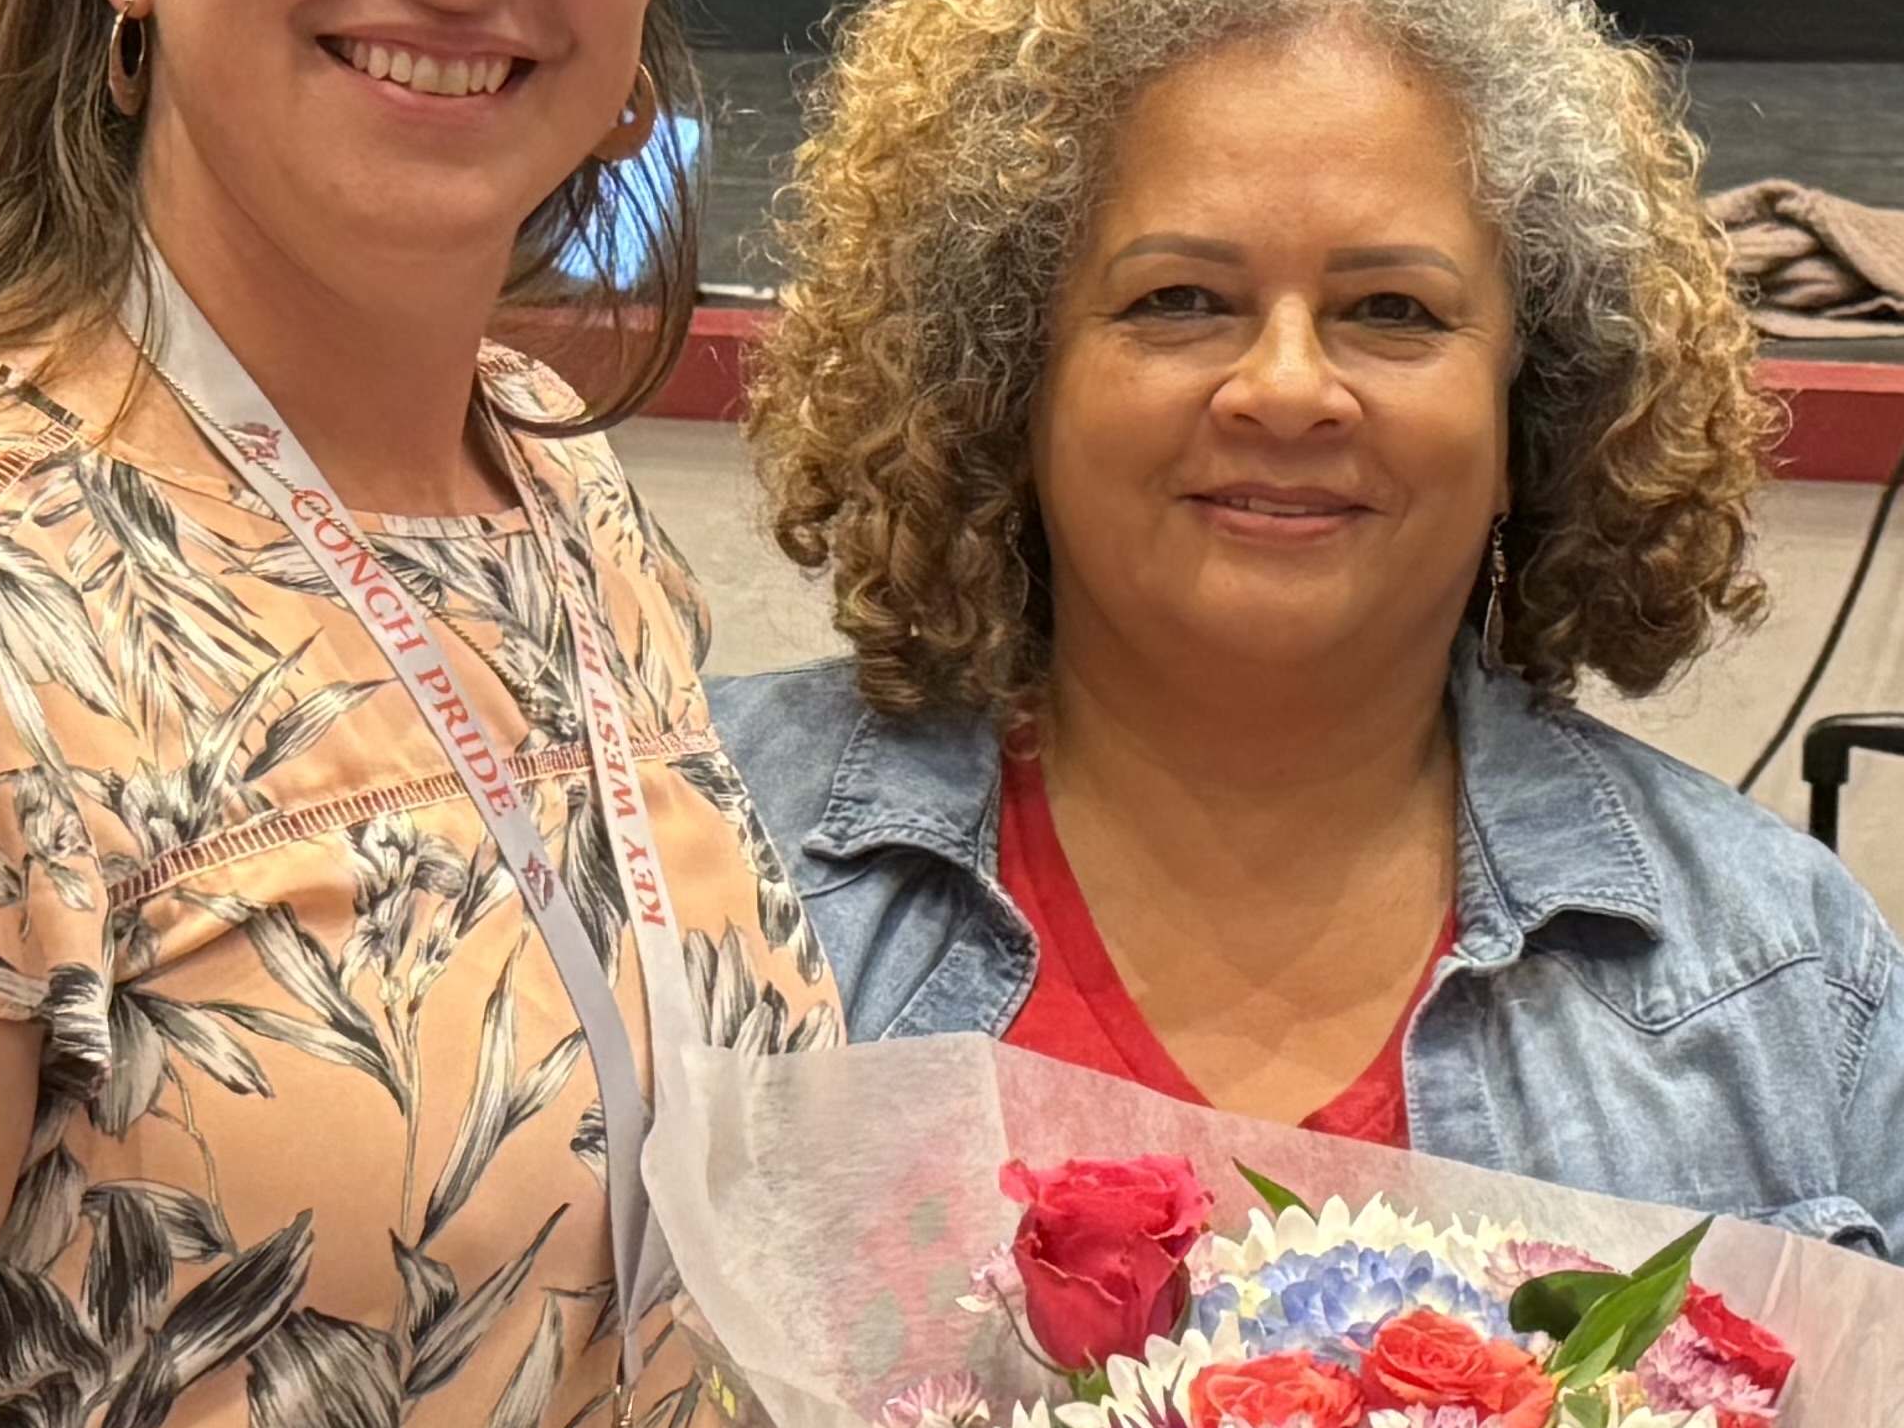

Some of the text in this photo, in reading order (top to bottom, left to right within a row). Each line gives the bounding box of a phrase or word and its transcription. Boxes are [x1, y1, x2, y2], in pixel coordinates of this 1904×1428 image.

[291, 489, 518, 817] CONCH PRIDE
[592, 688, 637, 818] WEST
[622, 834, 667, 927] KEY
